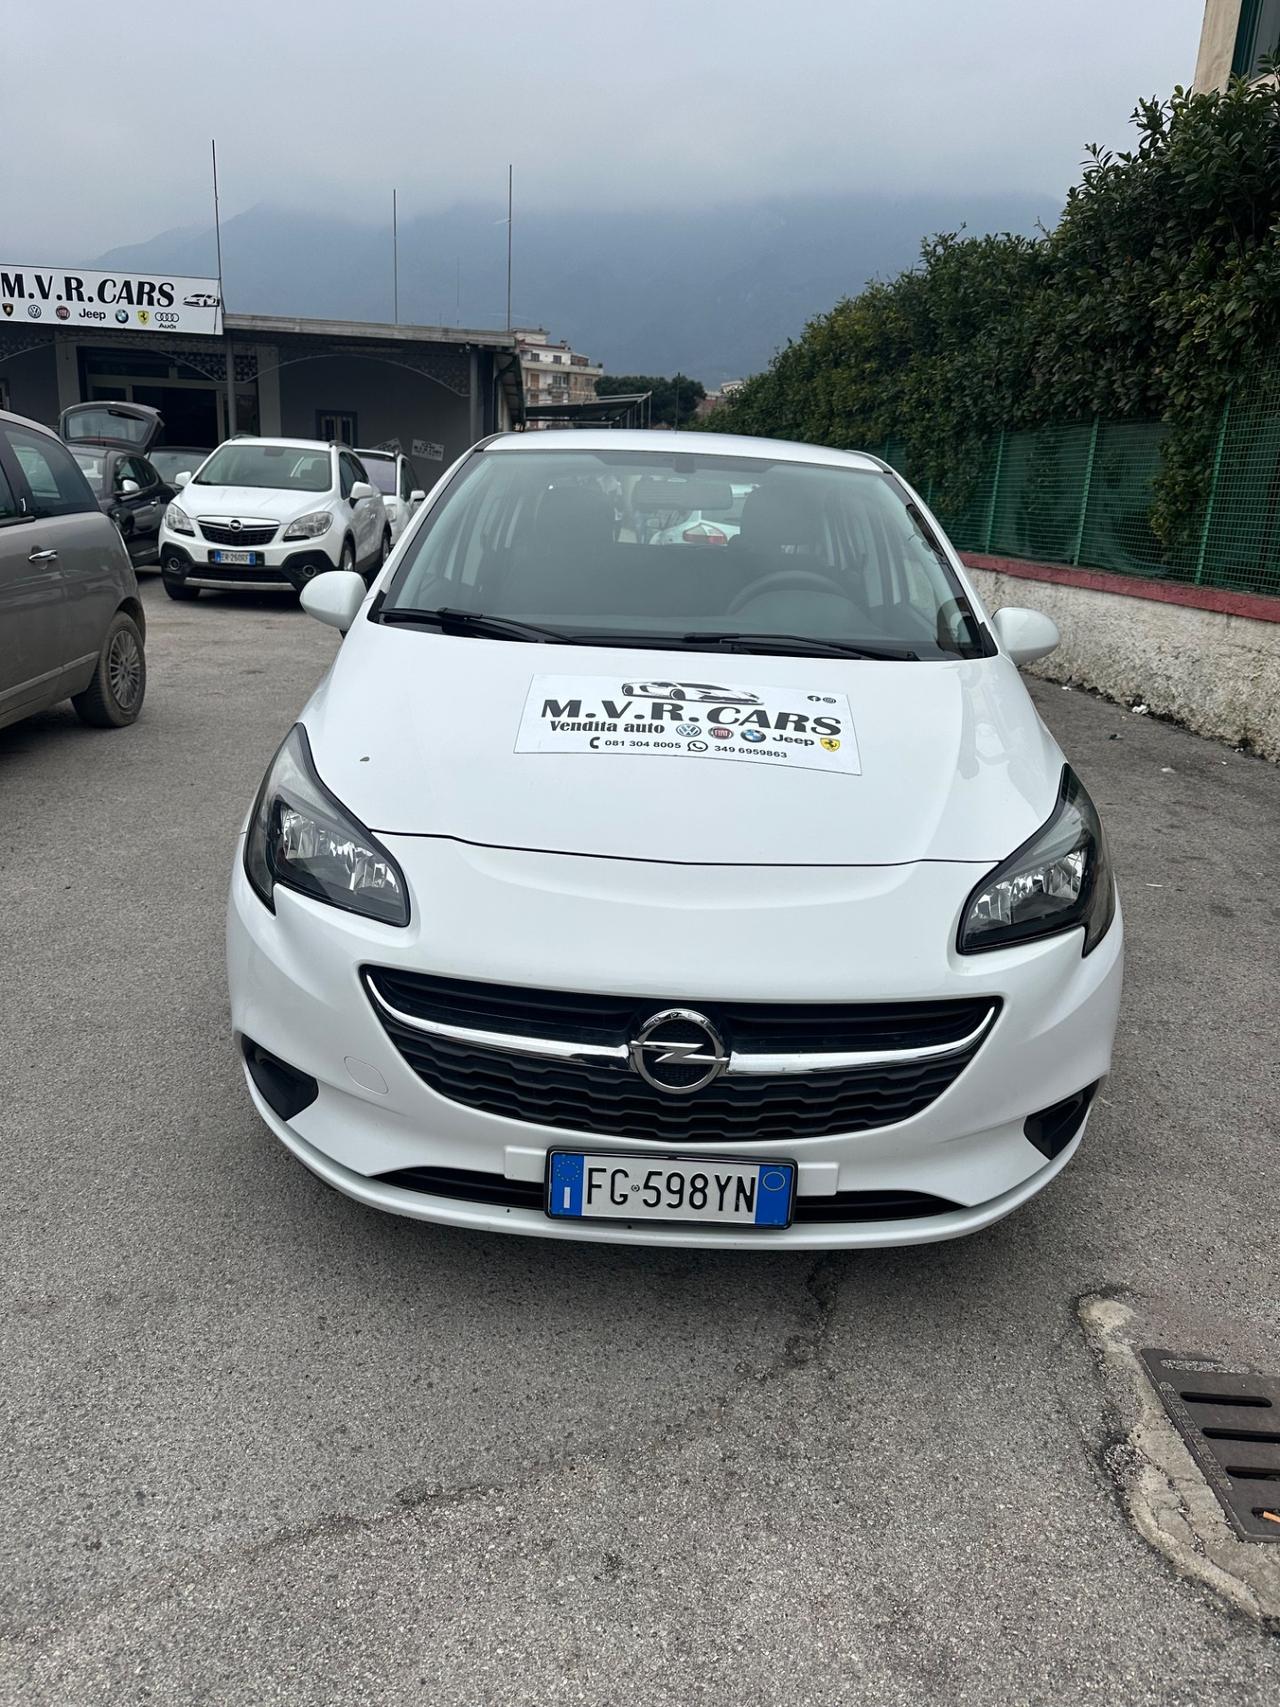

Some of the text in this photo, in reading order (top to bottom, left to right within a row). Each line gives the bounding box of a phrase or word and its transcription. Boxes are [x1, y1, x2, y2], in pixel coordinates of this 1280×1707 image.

[79, 308, 106, 321] Jeep
[541, 699, 842, 736] M.V.R.CARS
[550, 720, 666, 735] Vendita auto
[629, 740, 650, 748] 304
[653, 741, 682, 749] 8005
[772, 734, 815, 749] Jeep
[714, 745, 788, 759] 349 6959863
